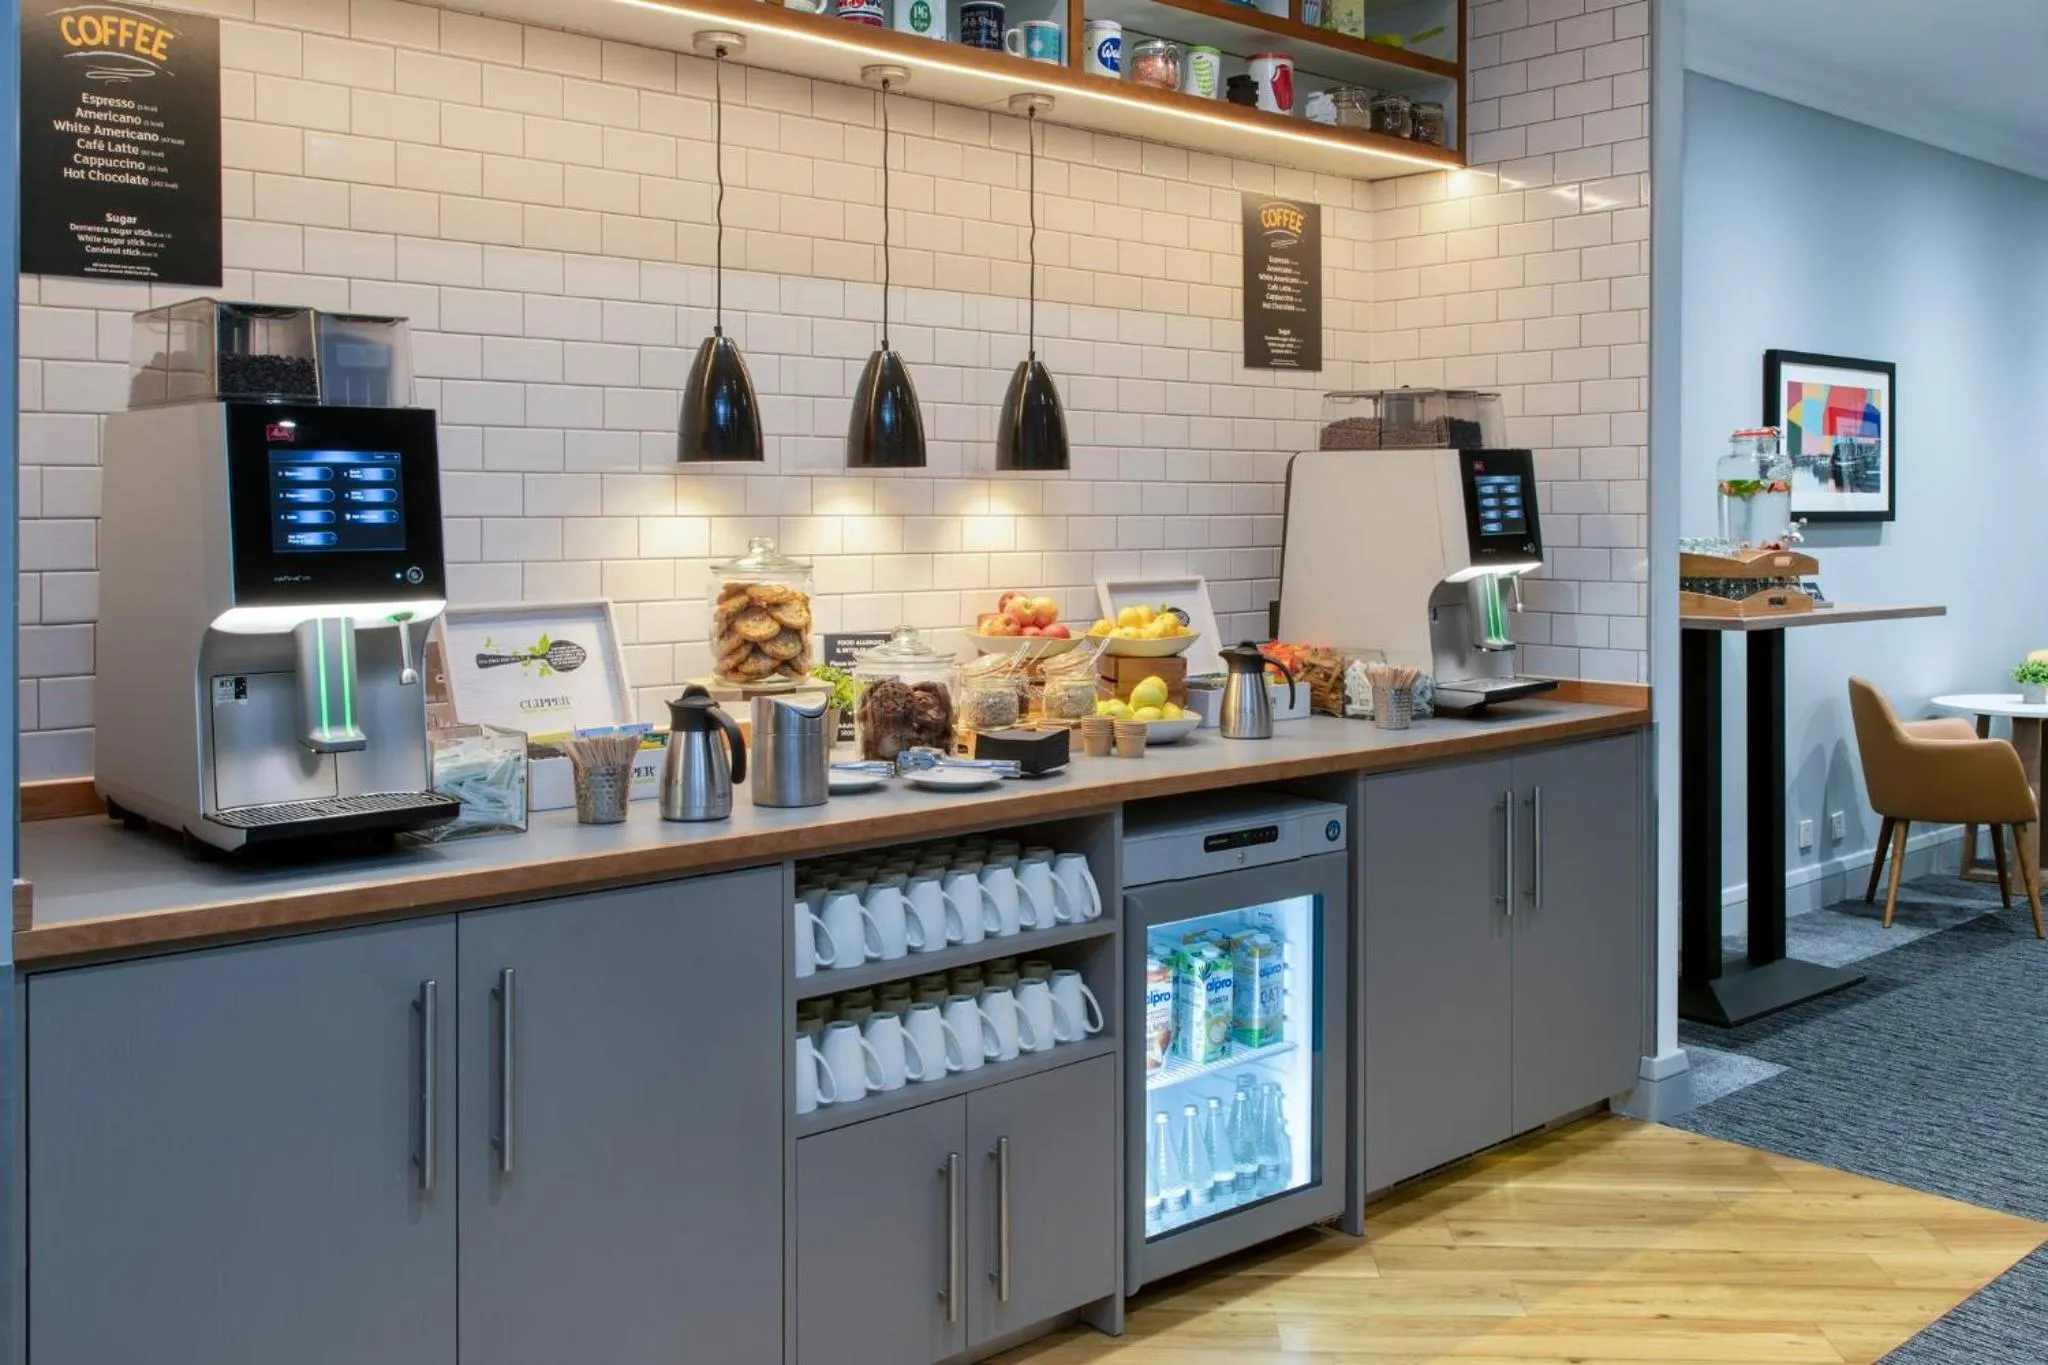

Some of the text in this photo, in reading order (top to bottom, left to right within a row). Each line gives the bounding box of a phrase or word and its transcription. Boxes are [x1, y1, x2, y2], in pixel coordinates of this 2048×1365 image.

[60, 15, 174, 61] COFFEE
[82, 92, 135, 109] Espresso
[75, 107, 142, 125] Americano
[53, 120, 91, 134] White
[94, 124, 159, 141] Americano
[76, 138, 105, 151] Café
[107, 141, 139, 155] Latte
[73, 153, 146, 170] Cappuccino
[63, 167, 85, 179] Hot
[88, 170, 149, 185] Chocolate
[105, 212, 137, 225] Sugar
[1261, 208, 1305, 234] COFFEE
[77, 234, 102, 242] White
[103, 236, 125, 246] sugar
[127, 238, 145, 247] stick
[110, 227, 132, 236] sugar
[134, 229, 152, 237] stick
[122, 247, 141, 256] stick
[519, 695, 571, 710] CLIPPER
[1259, 963, 1282, 979] alpro
[1206, 977, 1232, 994] alpro
